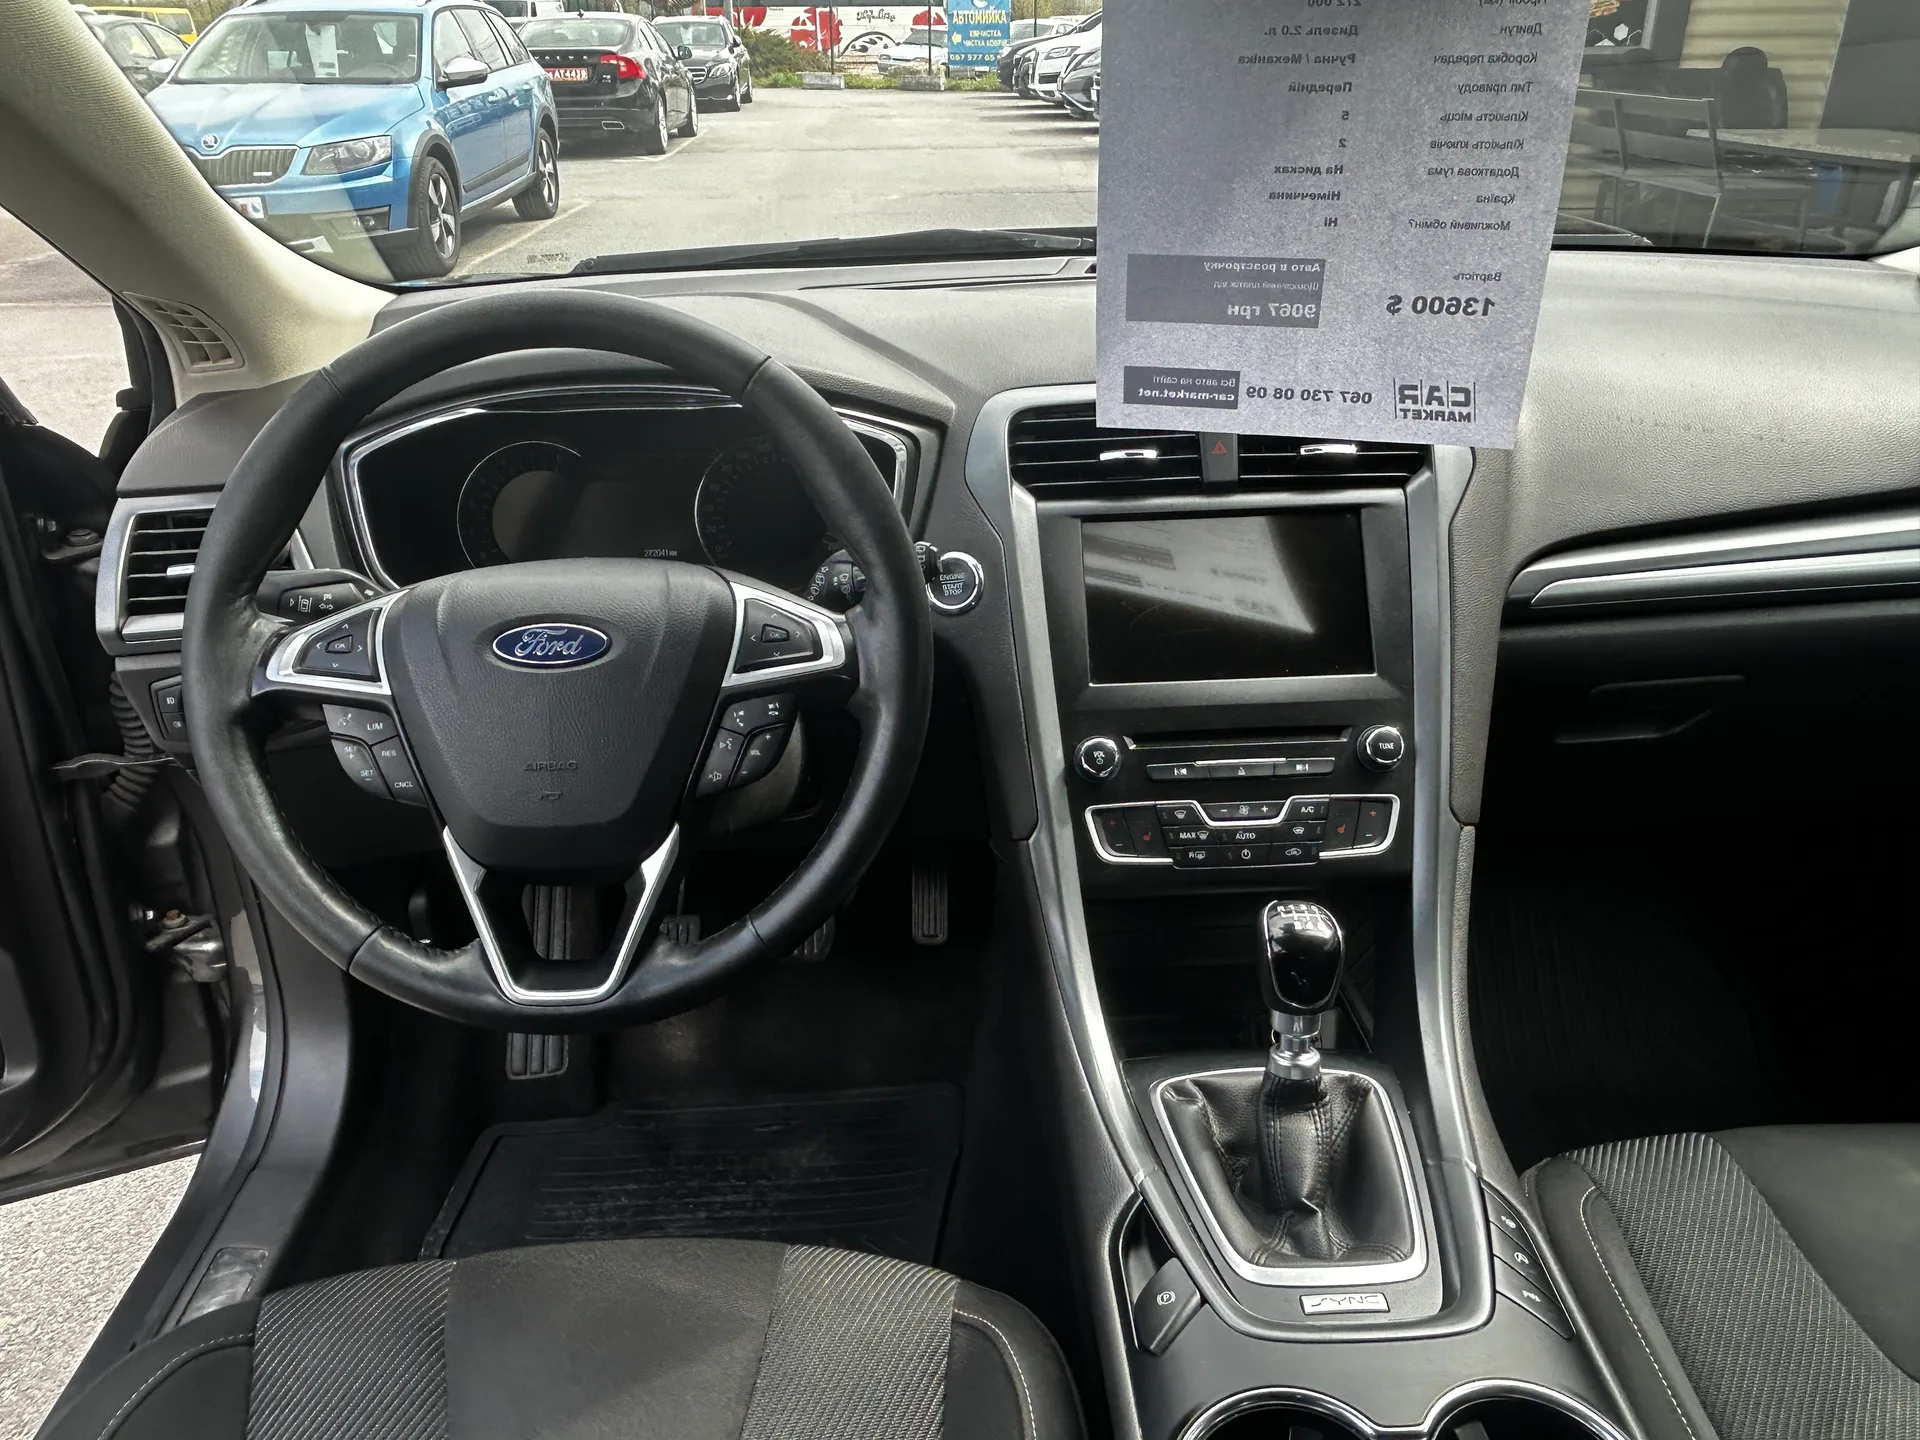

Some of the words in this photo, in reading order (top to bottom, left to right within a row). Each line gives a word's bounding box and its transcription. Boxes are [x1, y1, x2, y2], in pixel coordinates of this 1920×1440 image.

[952, 6, 1007, 24] АВТОМИЙКА
[940, 572, 964, 580] ENGINE
[942, 582, 964, 590] START
[944, 590, 962, 598] STOP
[514, 628, 584, 657] Ford
[367, 722, 383, 730] LIM
[1378, 742, 1394, 750] TUNE
[524, 760, 578, 772] AIRBAG
[1236, 832, 1256, 840] AUTO
[1311, 1294, 1380, 1307] SYNC
